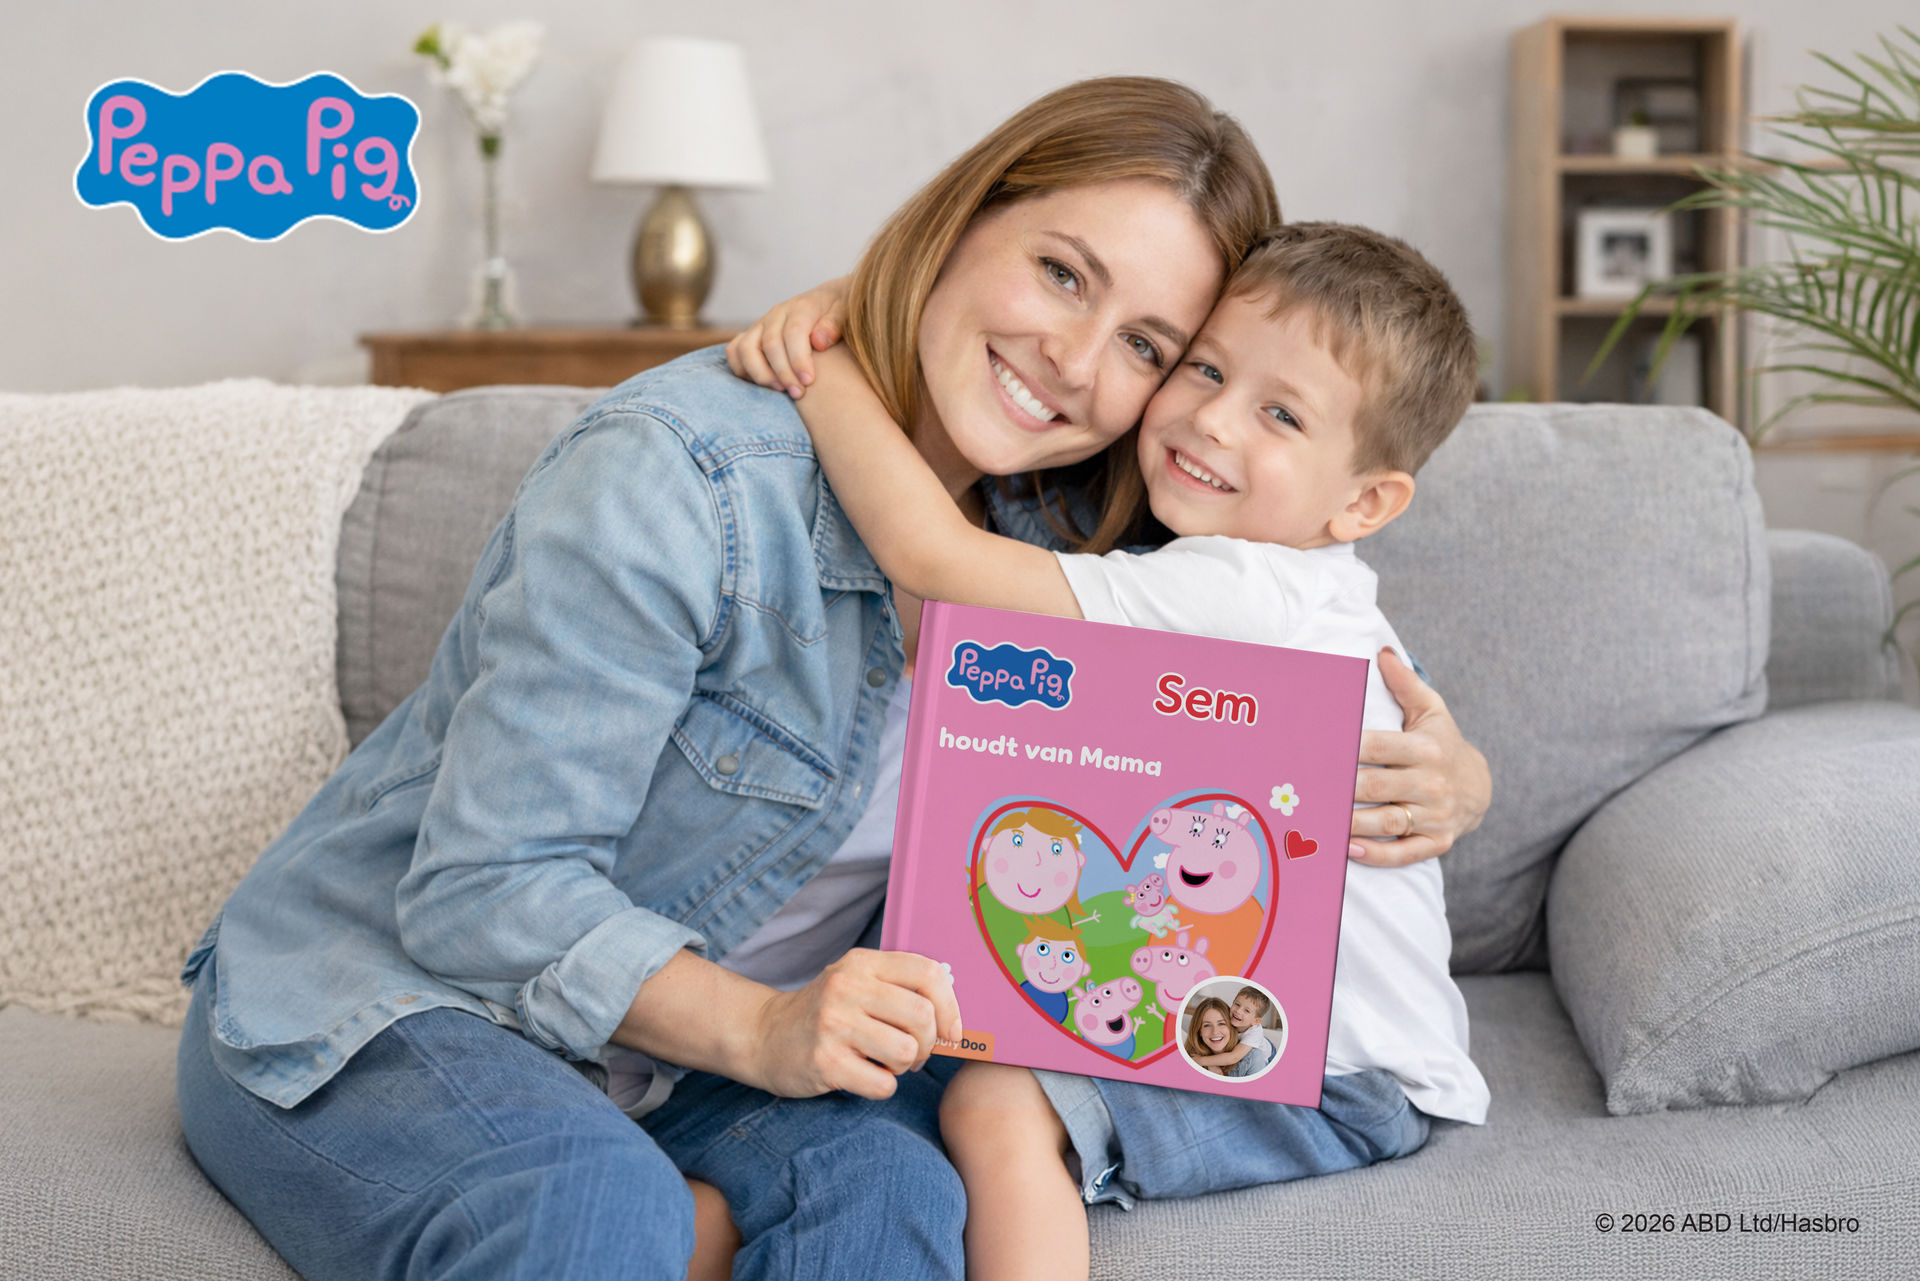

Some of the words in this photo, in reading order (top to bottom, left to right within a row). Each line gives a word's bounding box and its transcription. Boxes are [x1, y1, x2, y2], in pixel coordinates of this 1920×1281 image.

[959, 648, 1026, 693] Peppa
[1030, 658, 1065, 701] Pig
[1153, 672, 1259, 726] Sem
[939, 726, 1019, 757] houdt
[1024, 744, 1073, 765] van
[1079, 746, 1162, 777] Mama
